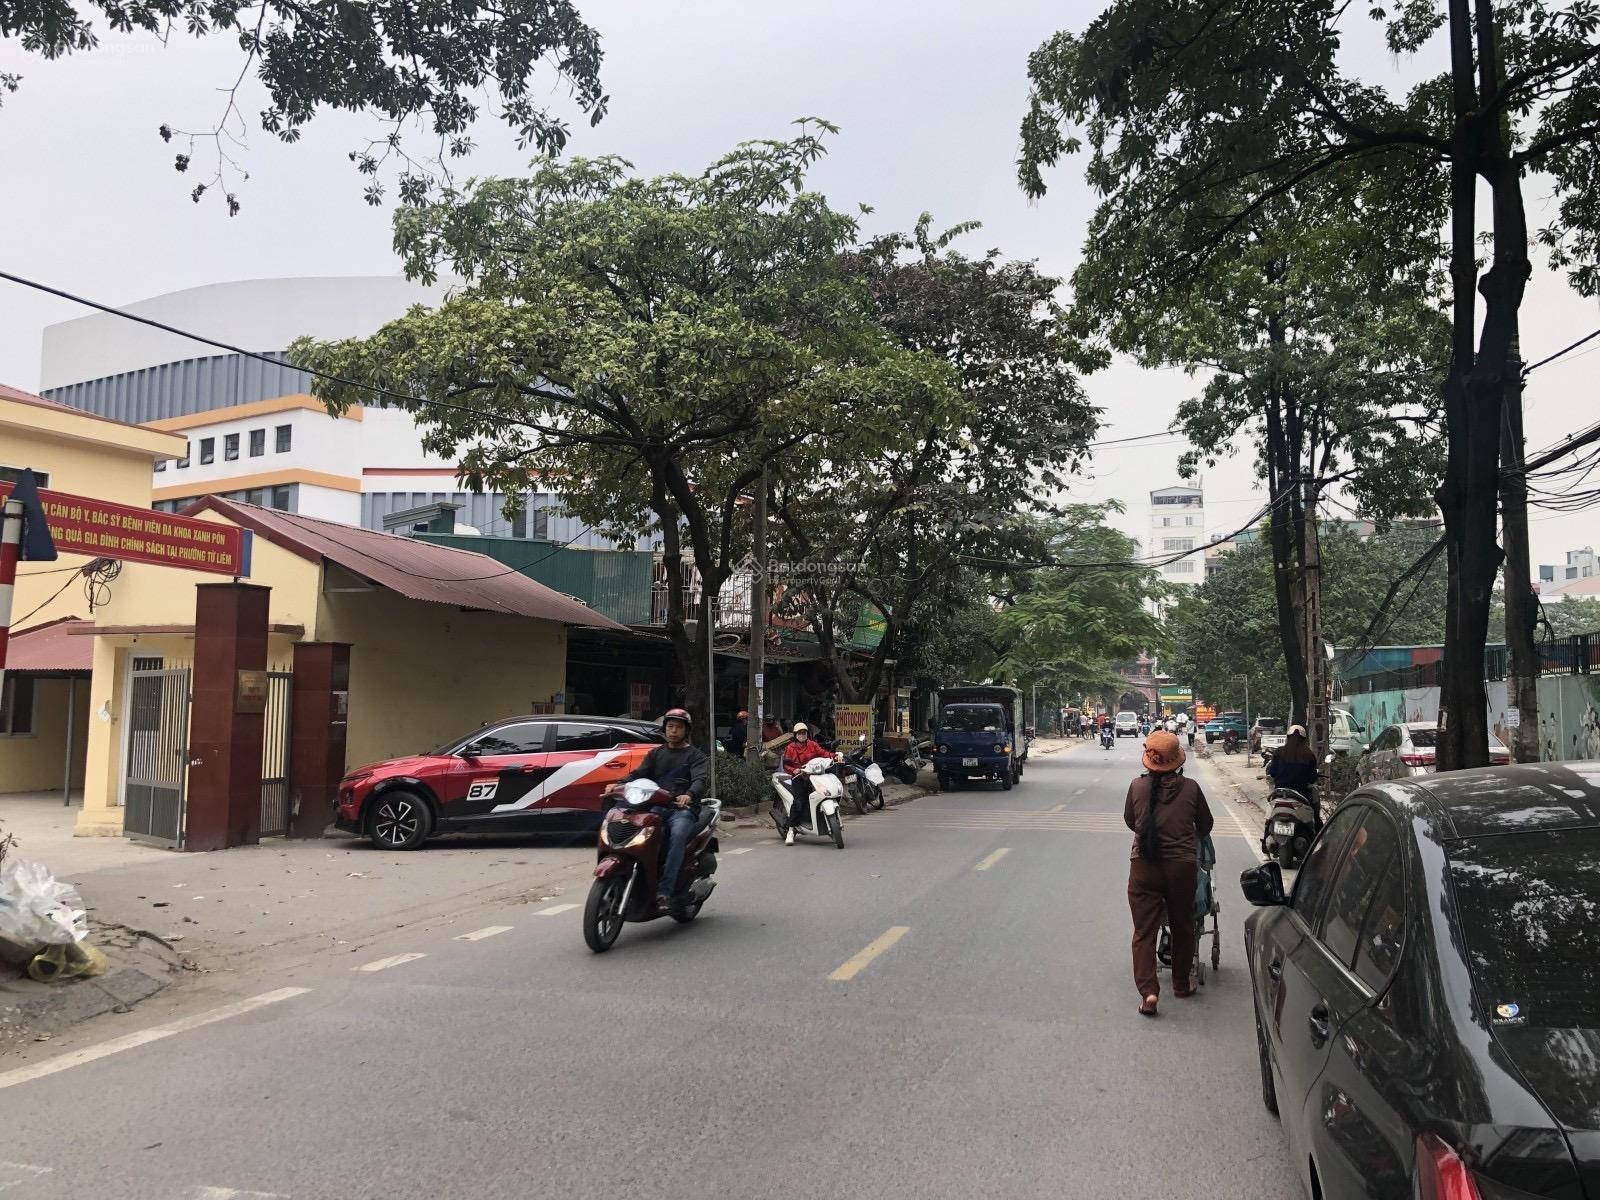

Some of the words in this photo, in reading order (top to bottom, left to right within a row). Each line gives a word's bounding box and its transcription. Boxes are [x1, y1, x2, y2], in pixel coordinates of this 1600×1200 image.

[51, 502, 68, 519] CÁN
[70, 505, 82, 523] BỘ
[84, 509, 90, 524] Y,
[92, 509, 108, 525] BÁC
[122, 515, 143, 532] BỆNH
[162, 523, 172, 537] ĐA
[173, 525, 192, 540] KHOA
[193, 529, 211, 543] XANH
[65, 527, 82, 543] QUÀ
[84, 531, 98, 545] GIA
[100, 532, 120, 549] ĐÌNH
[121, 536, 144, 552] CHÍNH
[146, 540, 165, 556] SÁCH
[166, 544, 178, 560] TẠI
[179, 545, 207, 562] PHƯỜNG
[216, 551, 232, 566] LIÊM
[836, 711, 869, 727] PHOTOCOPY
[470, 784, 497, 798] 87
